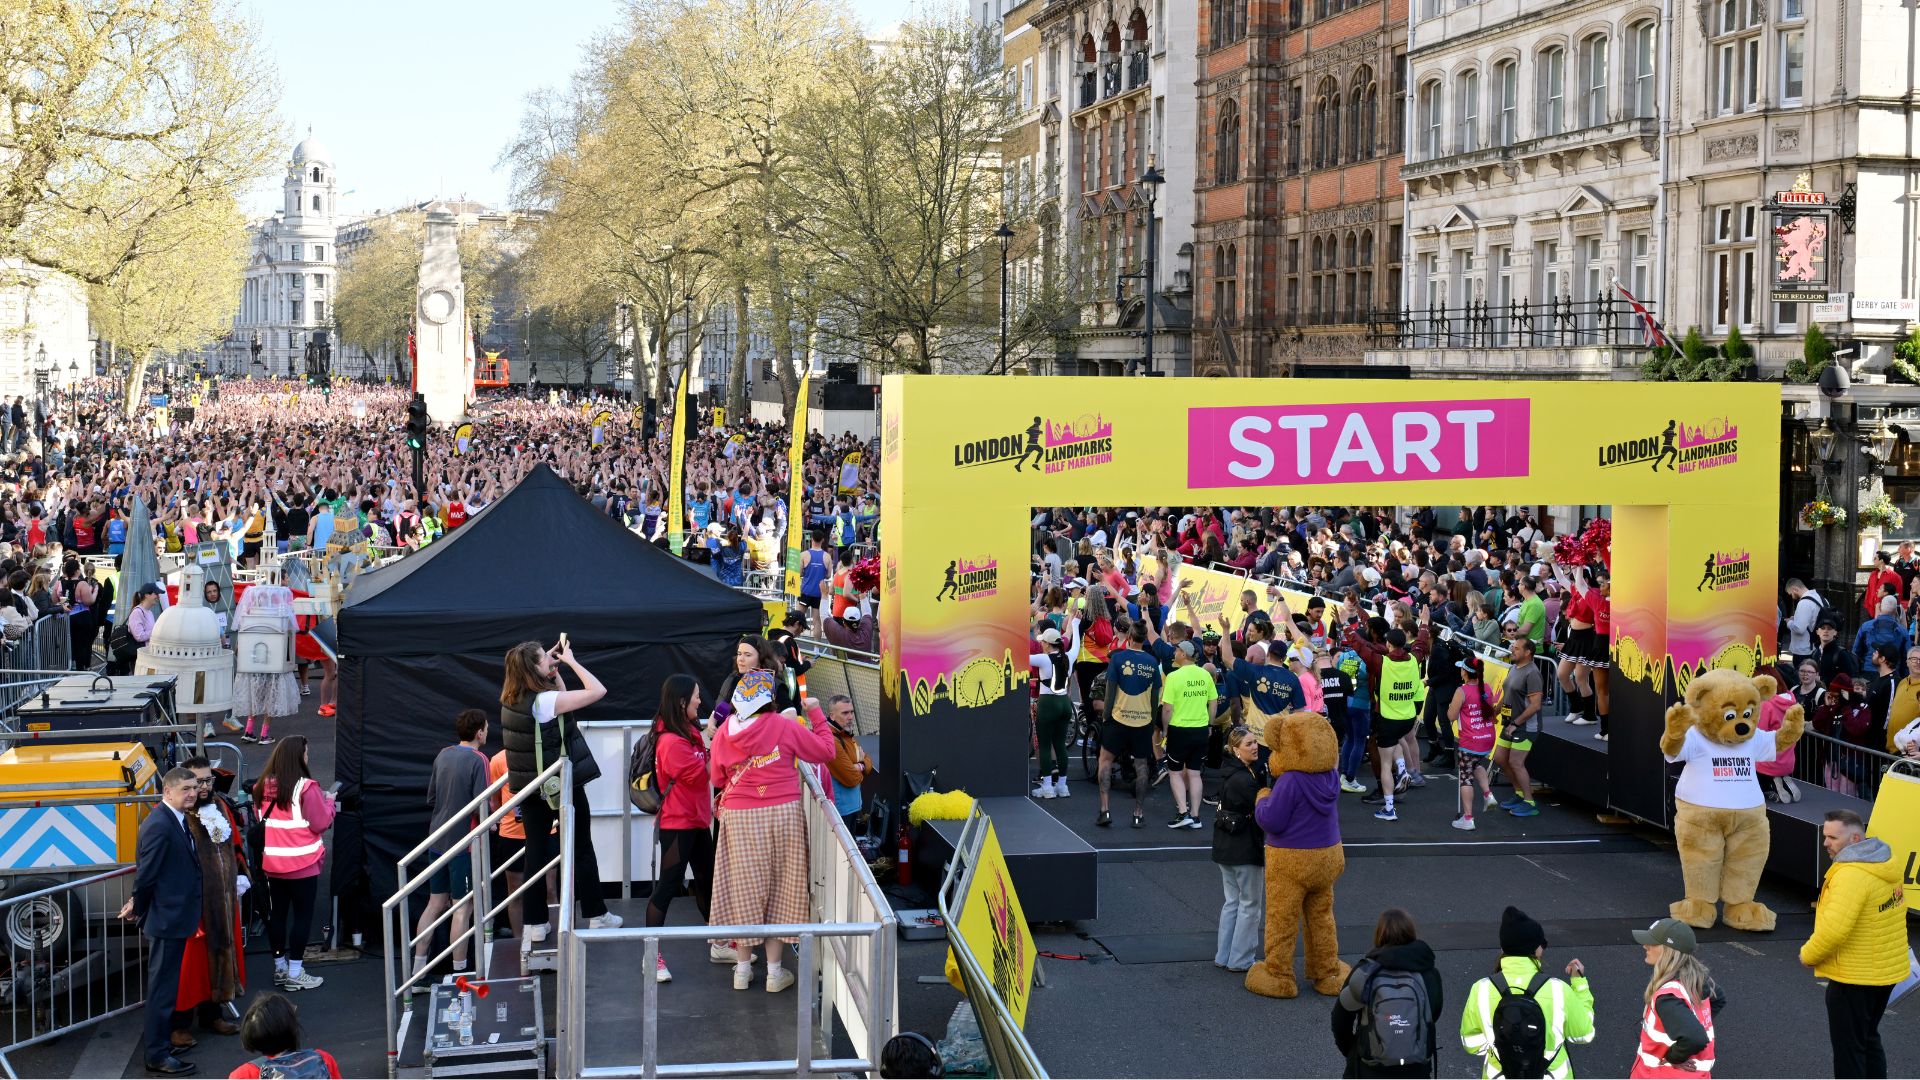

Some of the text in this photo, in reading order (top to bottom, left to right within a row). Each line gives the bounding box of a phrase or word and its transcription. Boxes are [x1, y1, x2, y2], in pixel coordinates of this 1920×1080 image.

[1815, 305, 1833, 313] STREET
[1856, 300, 1914, 310] DERBY GATE SW1
[1871, 407, 1919, 419] THE
[954, 433, 1023, 467] LONDON
[1227, 409, 1495, 480] START
[1045, 438, 1112, 463] LANDMARKS
[1598, 436, 1660, 467] LONDON
[1678, 439, 1738, 463] LANDMARKS
[1045, 452, 1112, 474] HALF MARATHON
[1678, 453, 1738, 474] HALF MARATHON
[1716, 560, 1750, 578] LONDON
[958, 567, 997, 586] LONDON
[1716, 572, 1750, 586] LANDMARKS
[958, 580, 997, 595] LANDMARKS
[1137, 663, 1155, 672] Guide
[1137, 670, 1153, 679] Dogs
[1186, 679, 1206, 687] BLIND
[1273, 681, 1293, 691] Guide
[1393, 681, 1413, 690] GUIDE
[1183, 690, 1208, 698] RUNNER
[1271, 689, 1290, 699] Dogs
[1388, 692, 1415, 702] RUNNER
[1712, 757, 1751, 767] WINSTON'S
[1713, 767, 1734, 777] WISH
